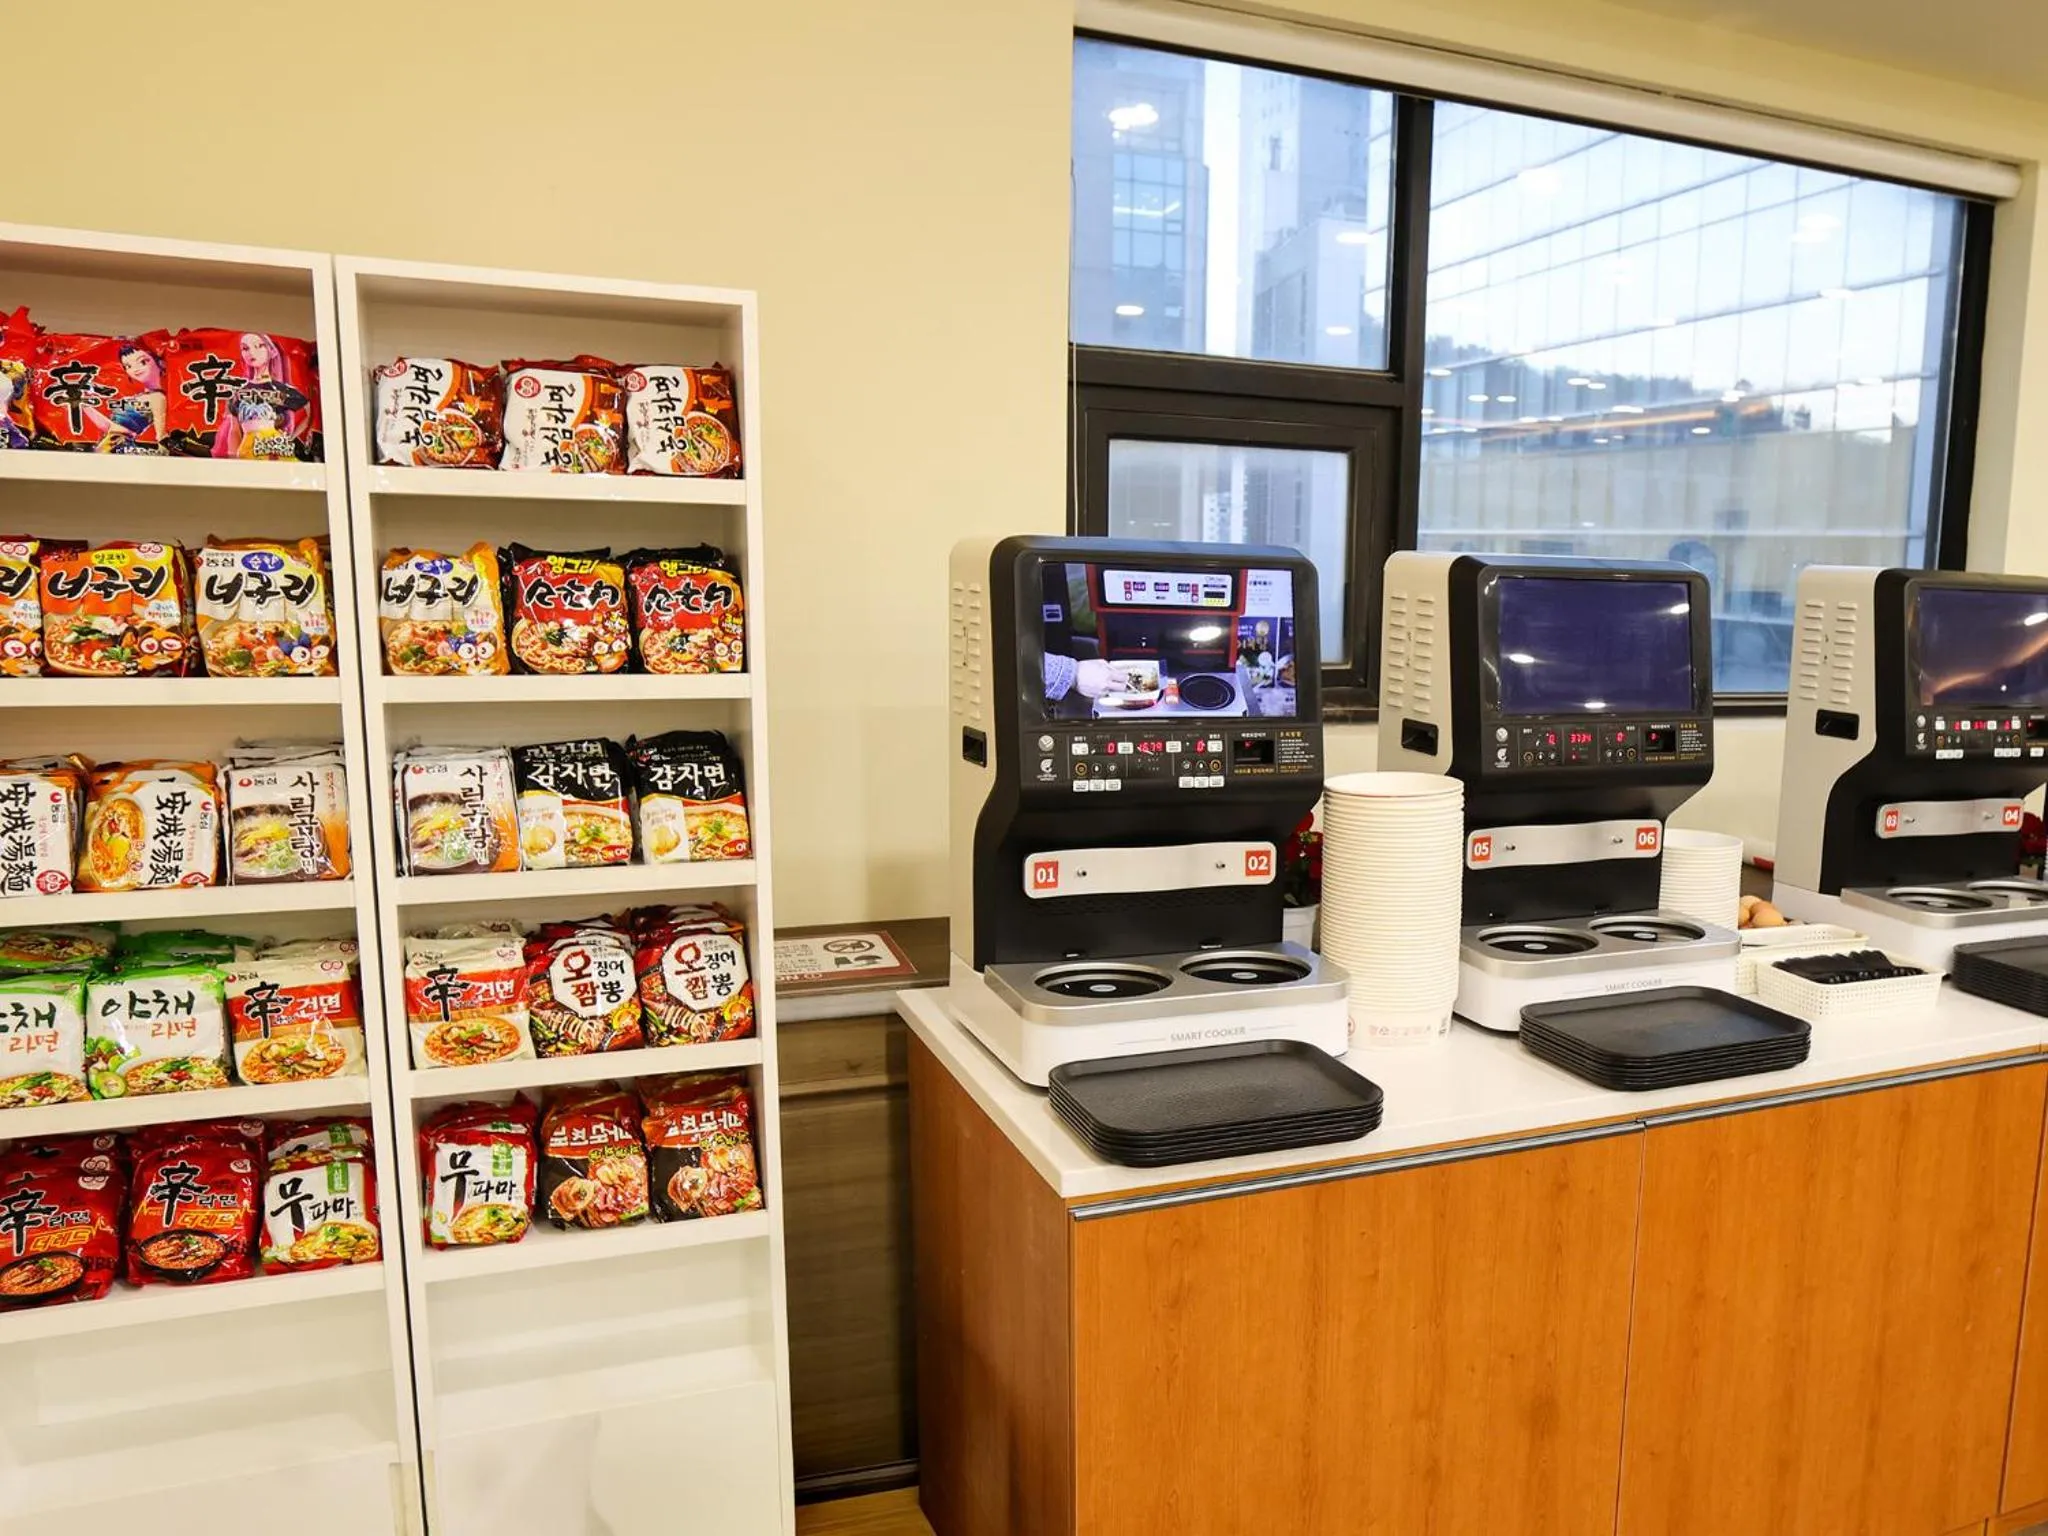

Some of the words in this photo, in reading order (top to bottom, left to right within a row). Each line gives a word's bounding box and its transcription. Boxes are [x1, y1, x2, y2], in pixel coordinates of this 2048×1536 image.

[46, 362, 116, 433] 辛
[183, 356, 246, 423] 辛
[48, 566, 166, 599] 너구리
[206, 572, 315, 605] 너구리
[384, 574, 478, 606] 너구리
[531, 762, 612, 788] 감자면
[649, 763, 727, 790] 감자면
[2004, 810, 2018, 822] 04
[1473, 842, 1489, 857] 05
[1638, 831, 1656, 845] 06
[1036, 868, 1056, 883] 01
[1248, 856, 1268, 871] 02
[563, 949, 625, 983] 오징어
[675, 941, 736, 976] 오징어
[424, 964, 470, 1021] 辛
[571, 981, 625, 1007] 짬뽕
[685, 972, 734, 1000] 짬뽕
[101, 989, 195, 1020] 야채
[245, 981, 292, 1038] 辛
[9, 1030, 59, 1053] 라면
[151, 1018, 197, 1039] 라면
[1170, 1031, 1202, 1042] SMART
[1203, 1026, 1246, 1039] COOKER
[152, 1161, 209, 1225] 辛
[199, 1194, 237, 1207] 라면
[440, 1151, 516, 1207] 무파마
[270, 1177, 355, 1231] 무파마
